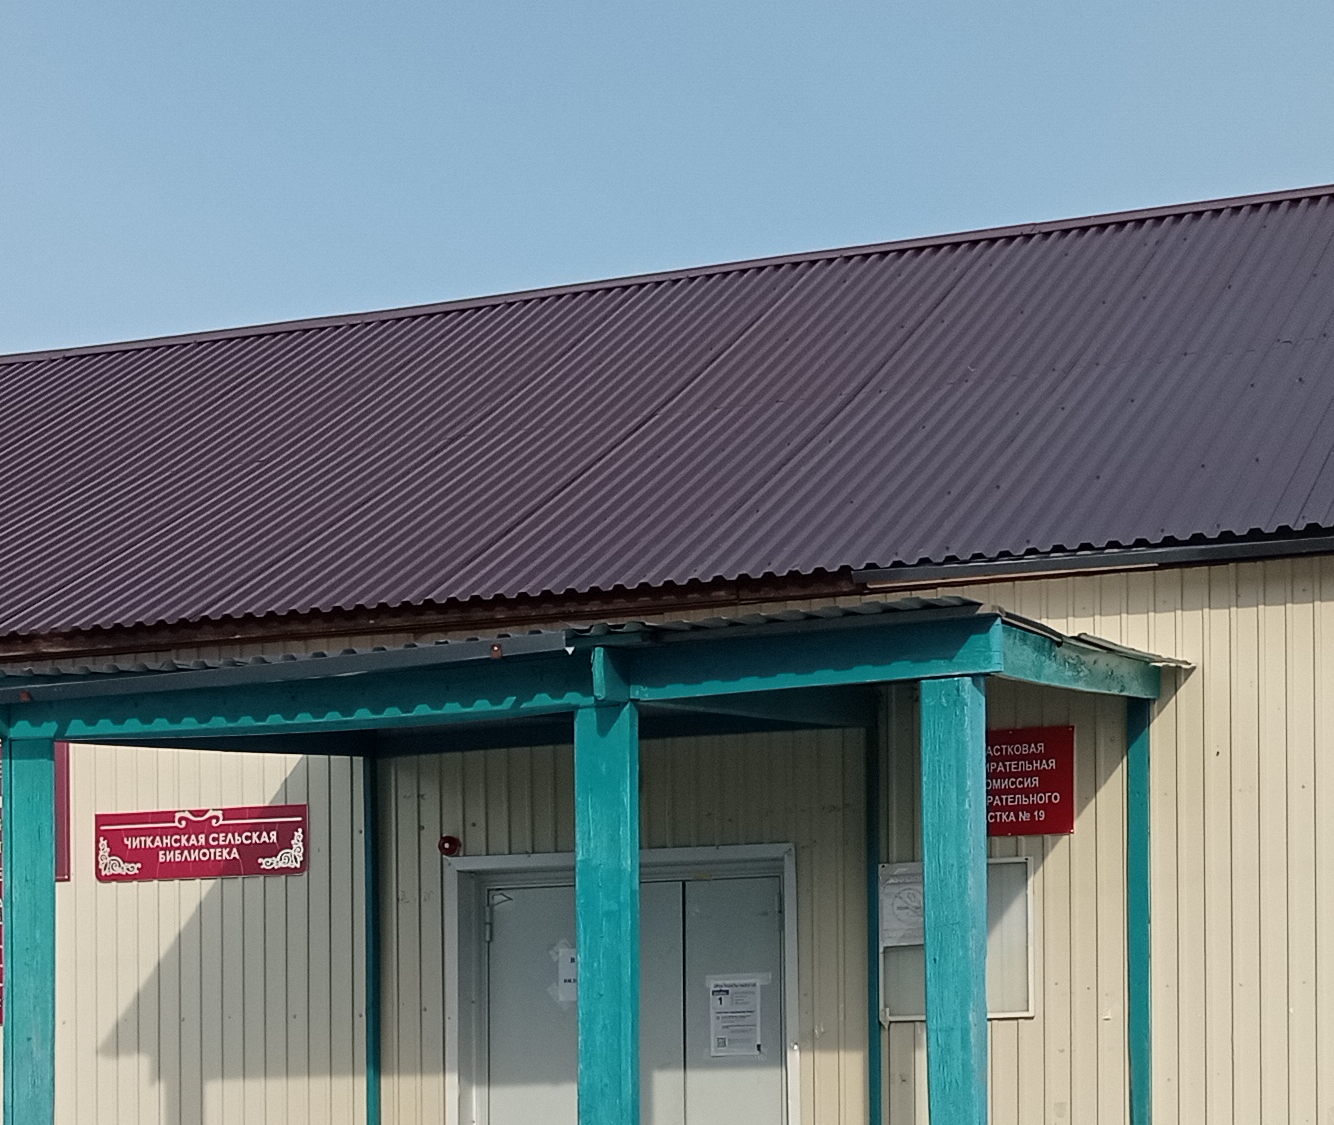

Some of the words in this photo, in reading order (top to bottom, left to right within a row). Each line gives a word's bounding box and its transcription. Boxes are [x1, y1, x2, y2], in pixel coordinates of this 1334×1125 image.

[987, 743, 1045, 757] АСТКОВАЯ
[987, 759, 1056, 773] РАТЕЛЬНАЯ
[986, 777, 1039, 790] ОМИССИЯ
[987, 792, 1060, 806] РАТЕЛЬНОГО
[987, 811, 1016, 823] СТКА
[1018, 811, 1031, 822] №
[1034, 810, 1045, 821] 19
[124, 834, 206, 849] ЧИТКАНСКАЯ
[209, 831, 277, 846] СЕЛЬСКАЯ
[158, 847, 240, 863] БИБЛИОТЕКА
